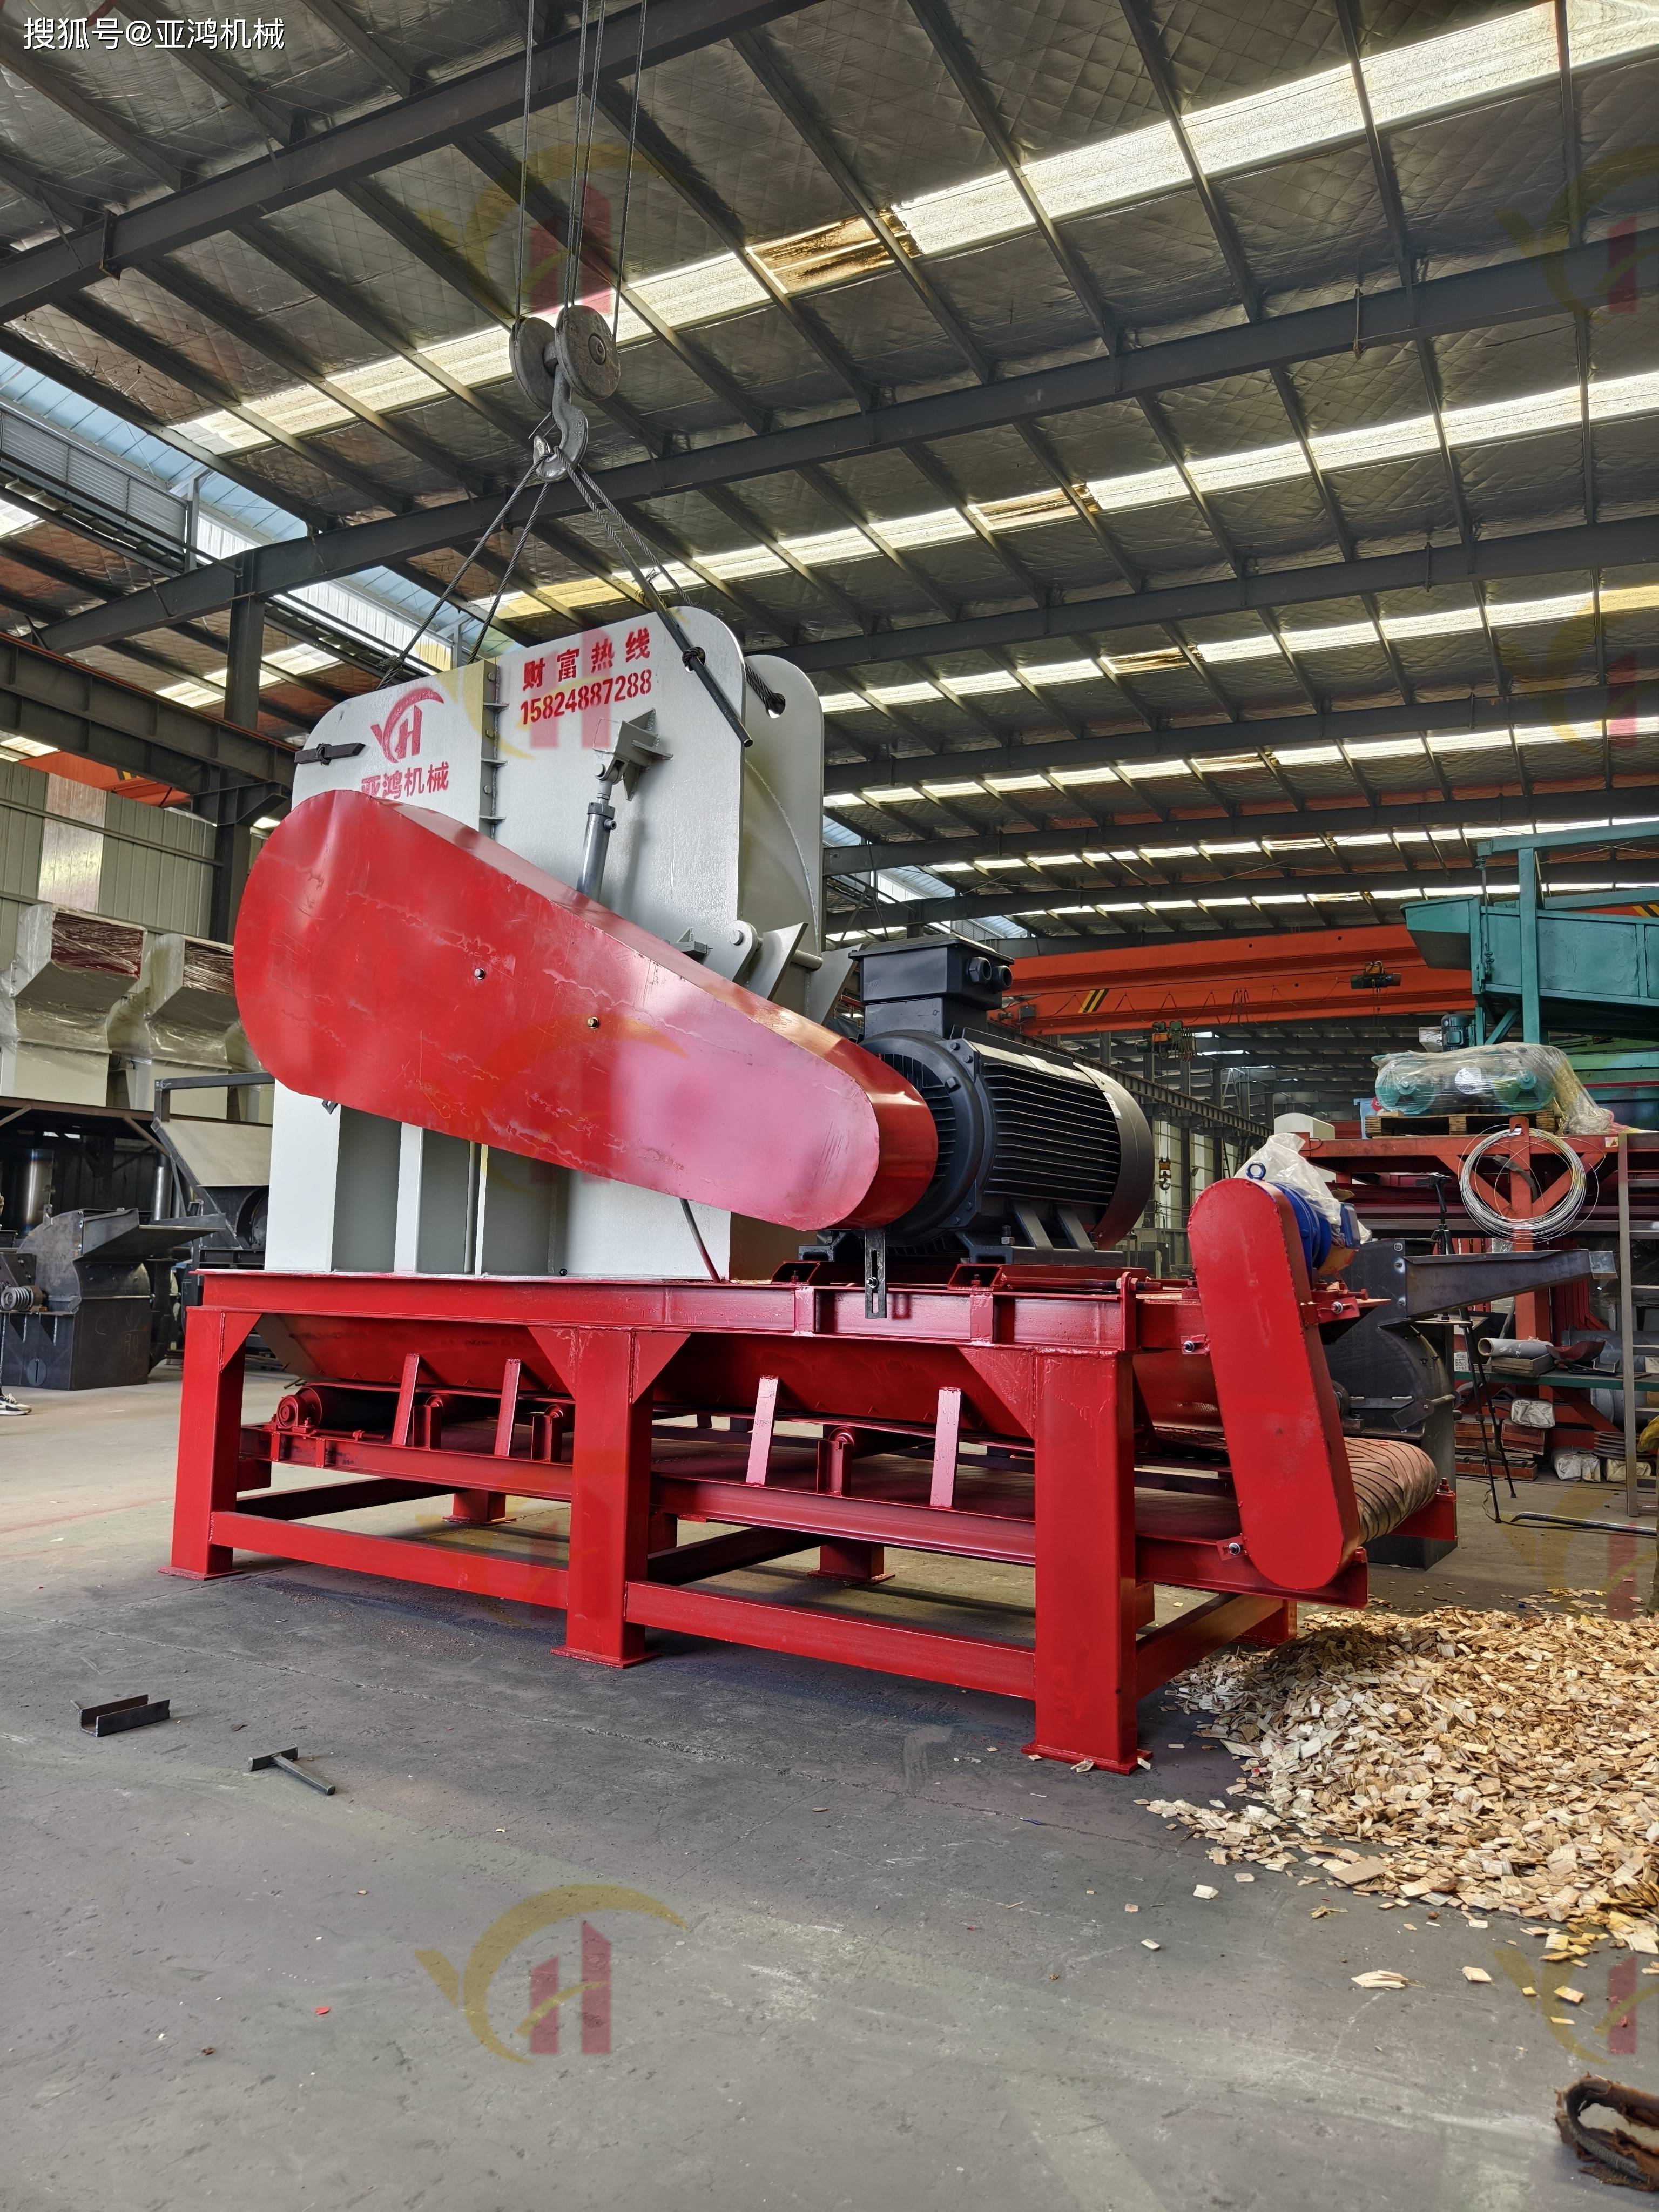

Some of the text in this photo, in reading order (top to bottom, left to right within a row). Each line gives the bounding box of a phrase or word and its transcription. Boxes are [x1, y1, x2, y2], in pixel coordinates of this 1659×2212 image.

[522, 628, 650, 691] 财富热线
[520, 669, 652, 725] 15824887288
[361, 761, 449, 800] 亚鸿机械
